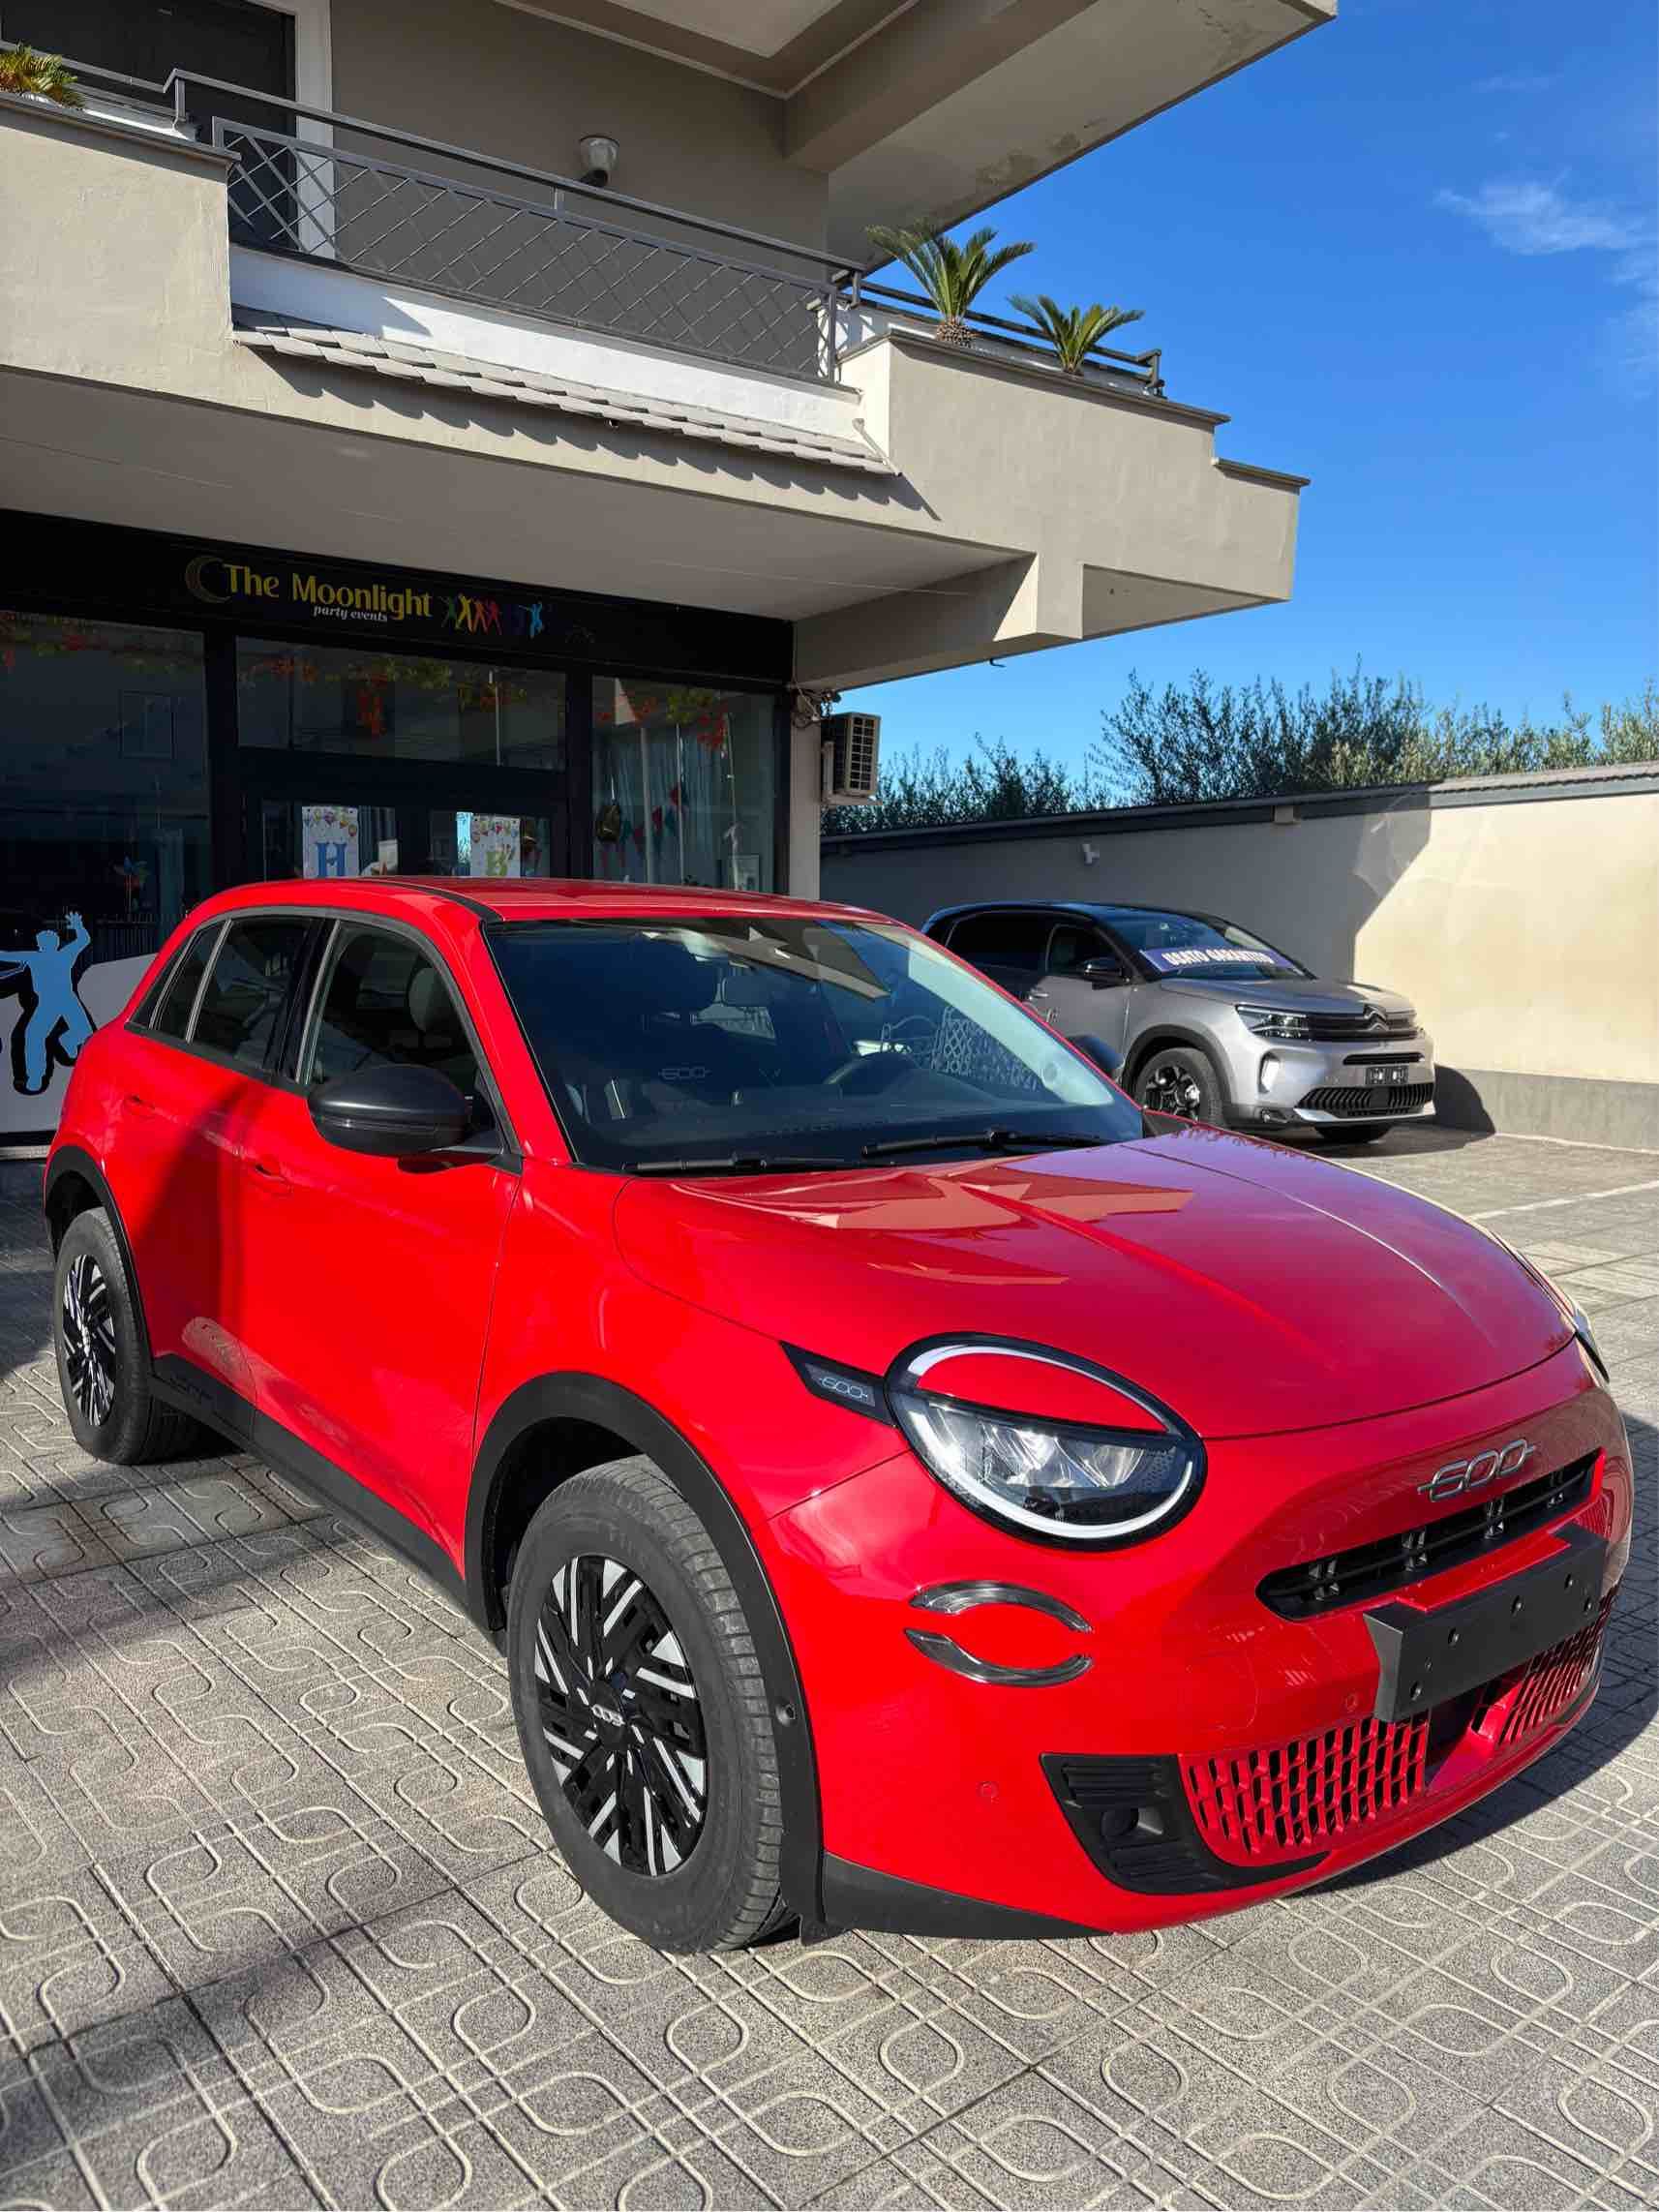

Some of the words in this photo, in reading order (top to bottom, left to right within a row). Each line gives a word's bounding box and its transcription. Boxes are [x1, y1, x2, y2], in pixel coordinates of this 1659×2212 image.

[223, 563, 280, 598] The
[293, 572, 433, 621] Moonlight
[314, 605, 347, 621] party
[349, 610, 388, 622] events
[819, 1377, 868, 1399] 600
[1417, 1439, 1537, 1503] 600
